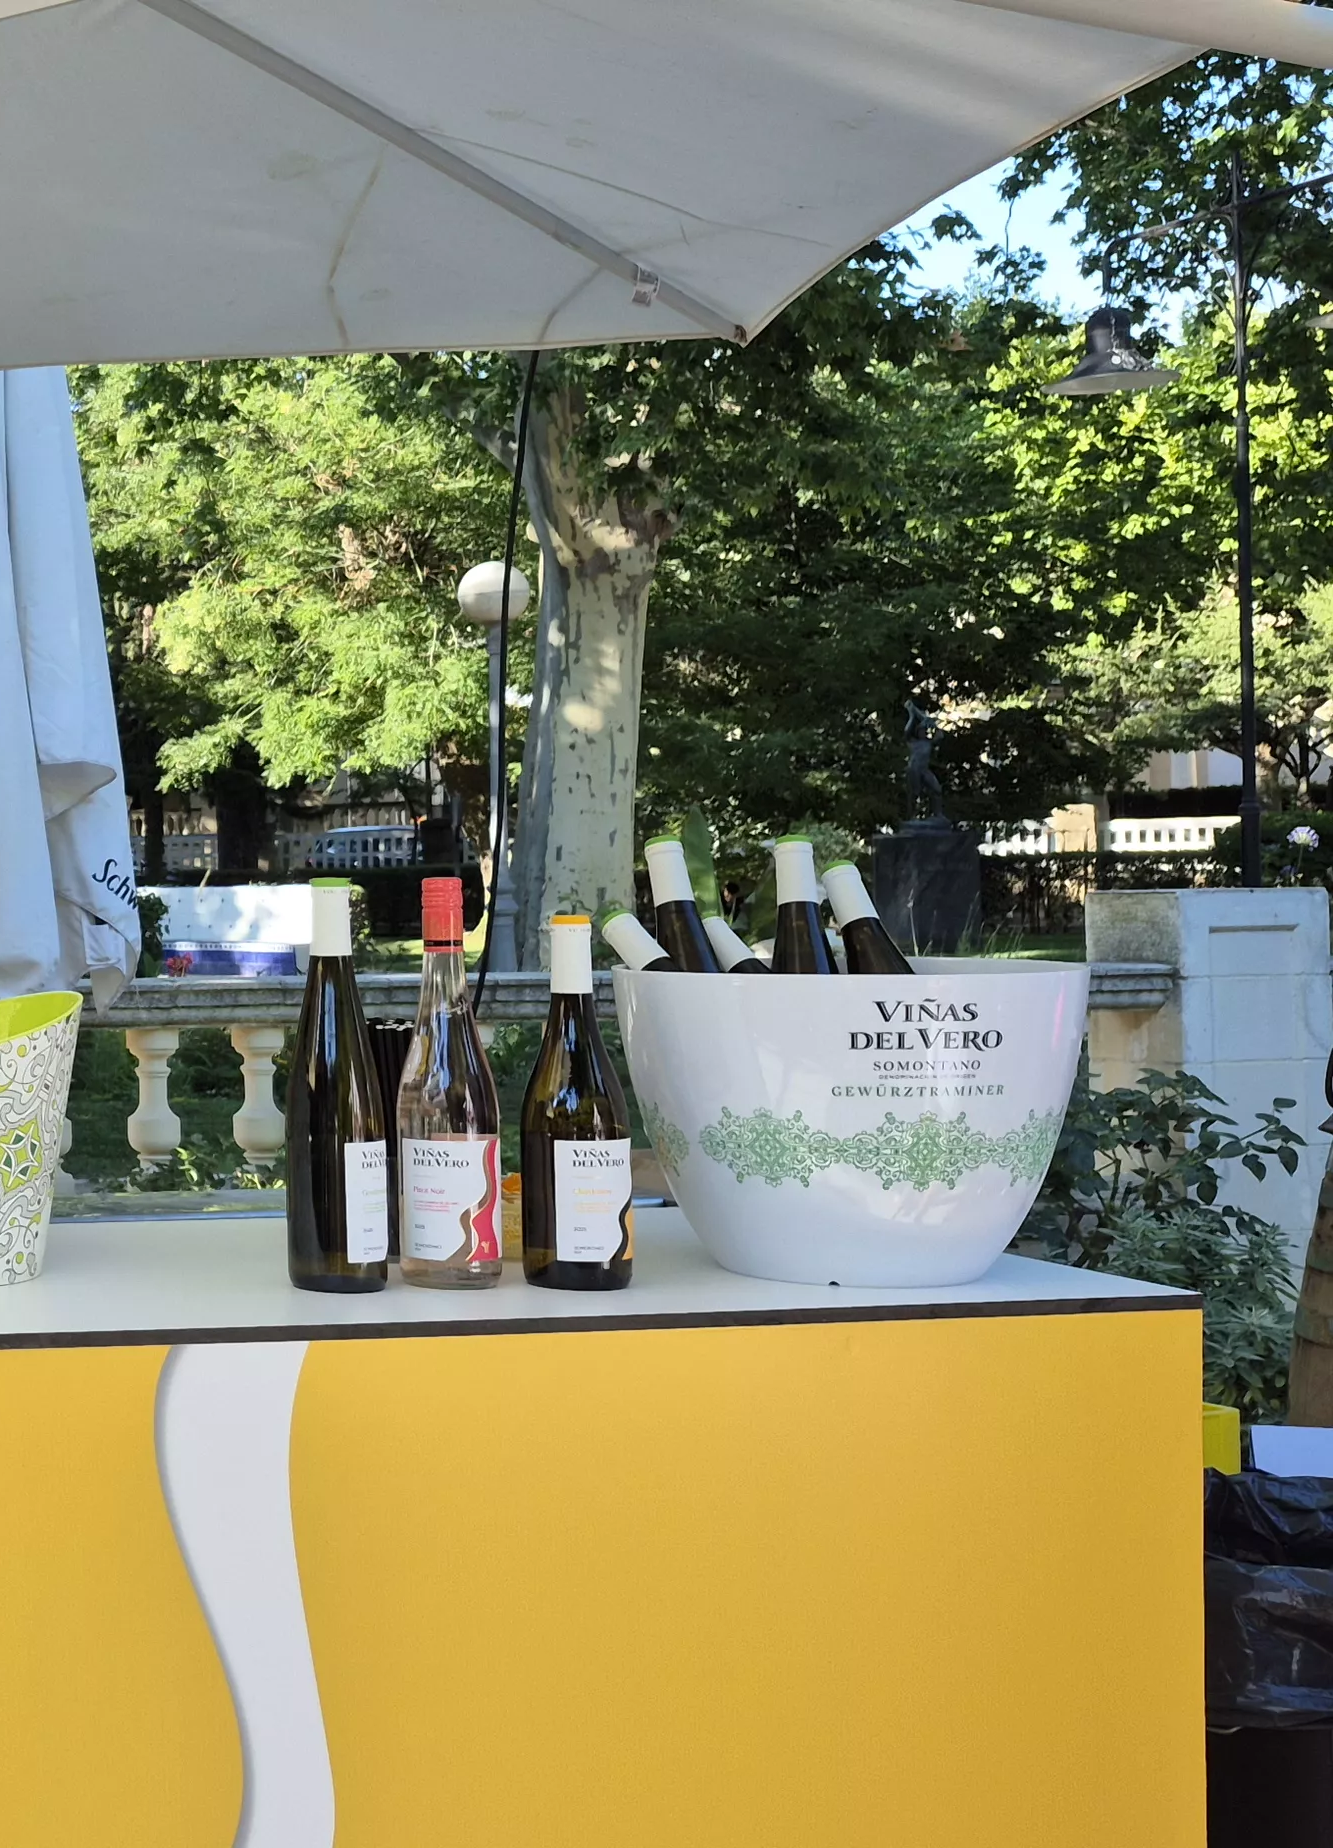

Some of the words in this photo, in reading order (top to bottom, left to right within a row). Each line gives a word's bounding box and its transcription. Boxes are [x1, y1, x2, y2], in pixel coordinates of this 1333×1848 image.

[872, 998, 979, 1023] VIÑAS
[848, 1031, 914, 1051] DEL
[914, 1028, 1003, 1052] VERO
[873, 1060, 981, 1072] SOMONTANO
[831, 1084, 1005, 1098] GEWÜRZTRAMINER
[413, 1147, 450, 1158] VIÑAS
[572, 1148, 611, 1158] VIÑAS
[413, 1158, 434, 1167] DEL
[433, 1158, 470, 1168] VERO
[572, 1160, 596, 1168] DEL
[595, 1158, 625, 1168] VERO
